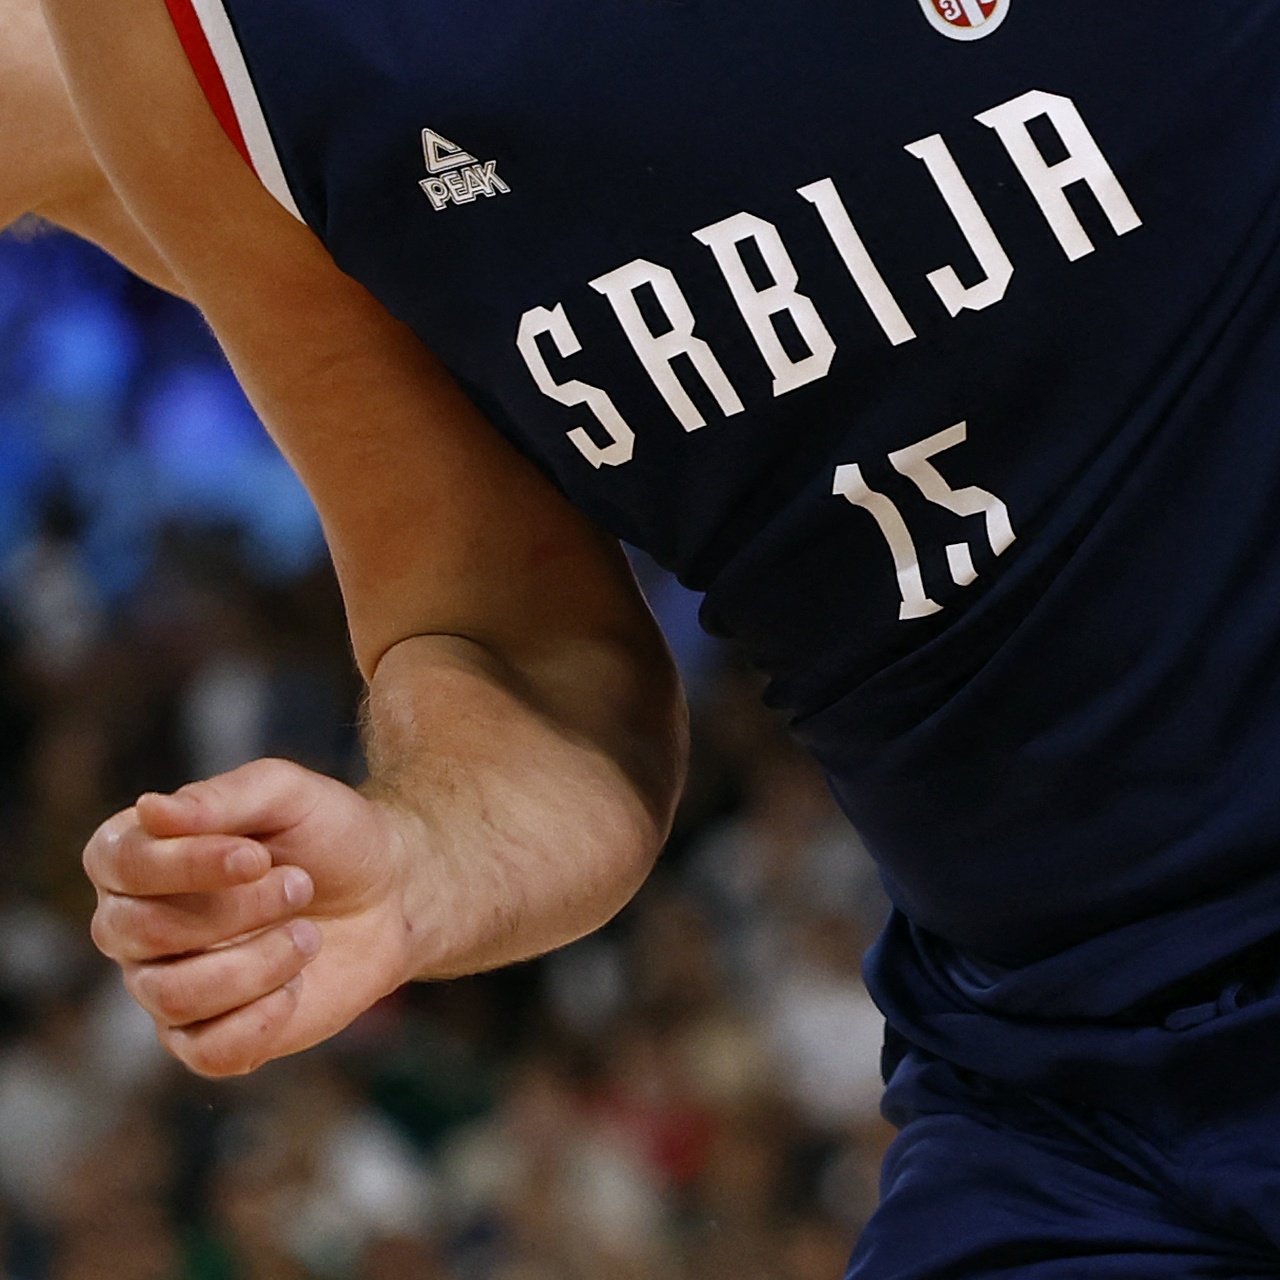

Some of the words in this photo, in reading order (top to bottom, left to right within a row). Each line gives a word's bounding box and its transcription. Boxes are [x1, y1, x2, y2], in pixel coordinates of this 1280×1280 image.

[418, 160, 511, 211] PEAK
[516, 89, 1143, 470] SRBIJA
[831, 420, 1017, 621] 15
